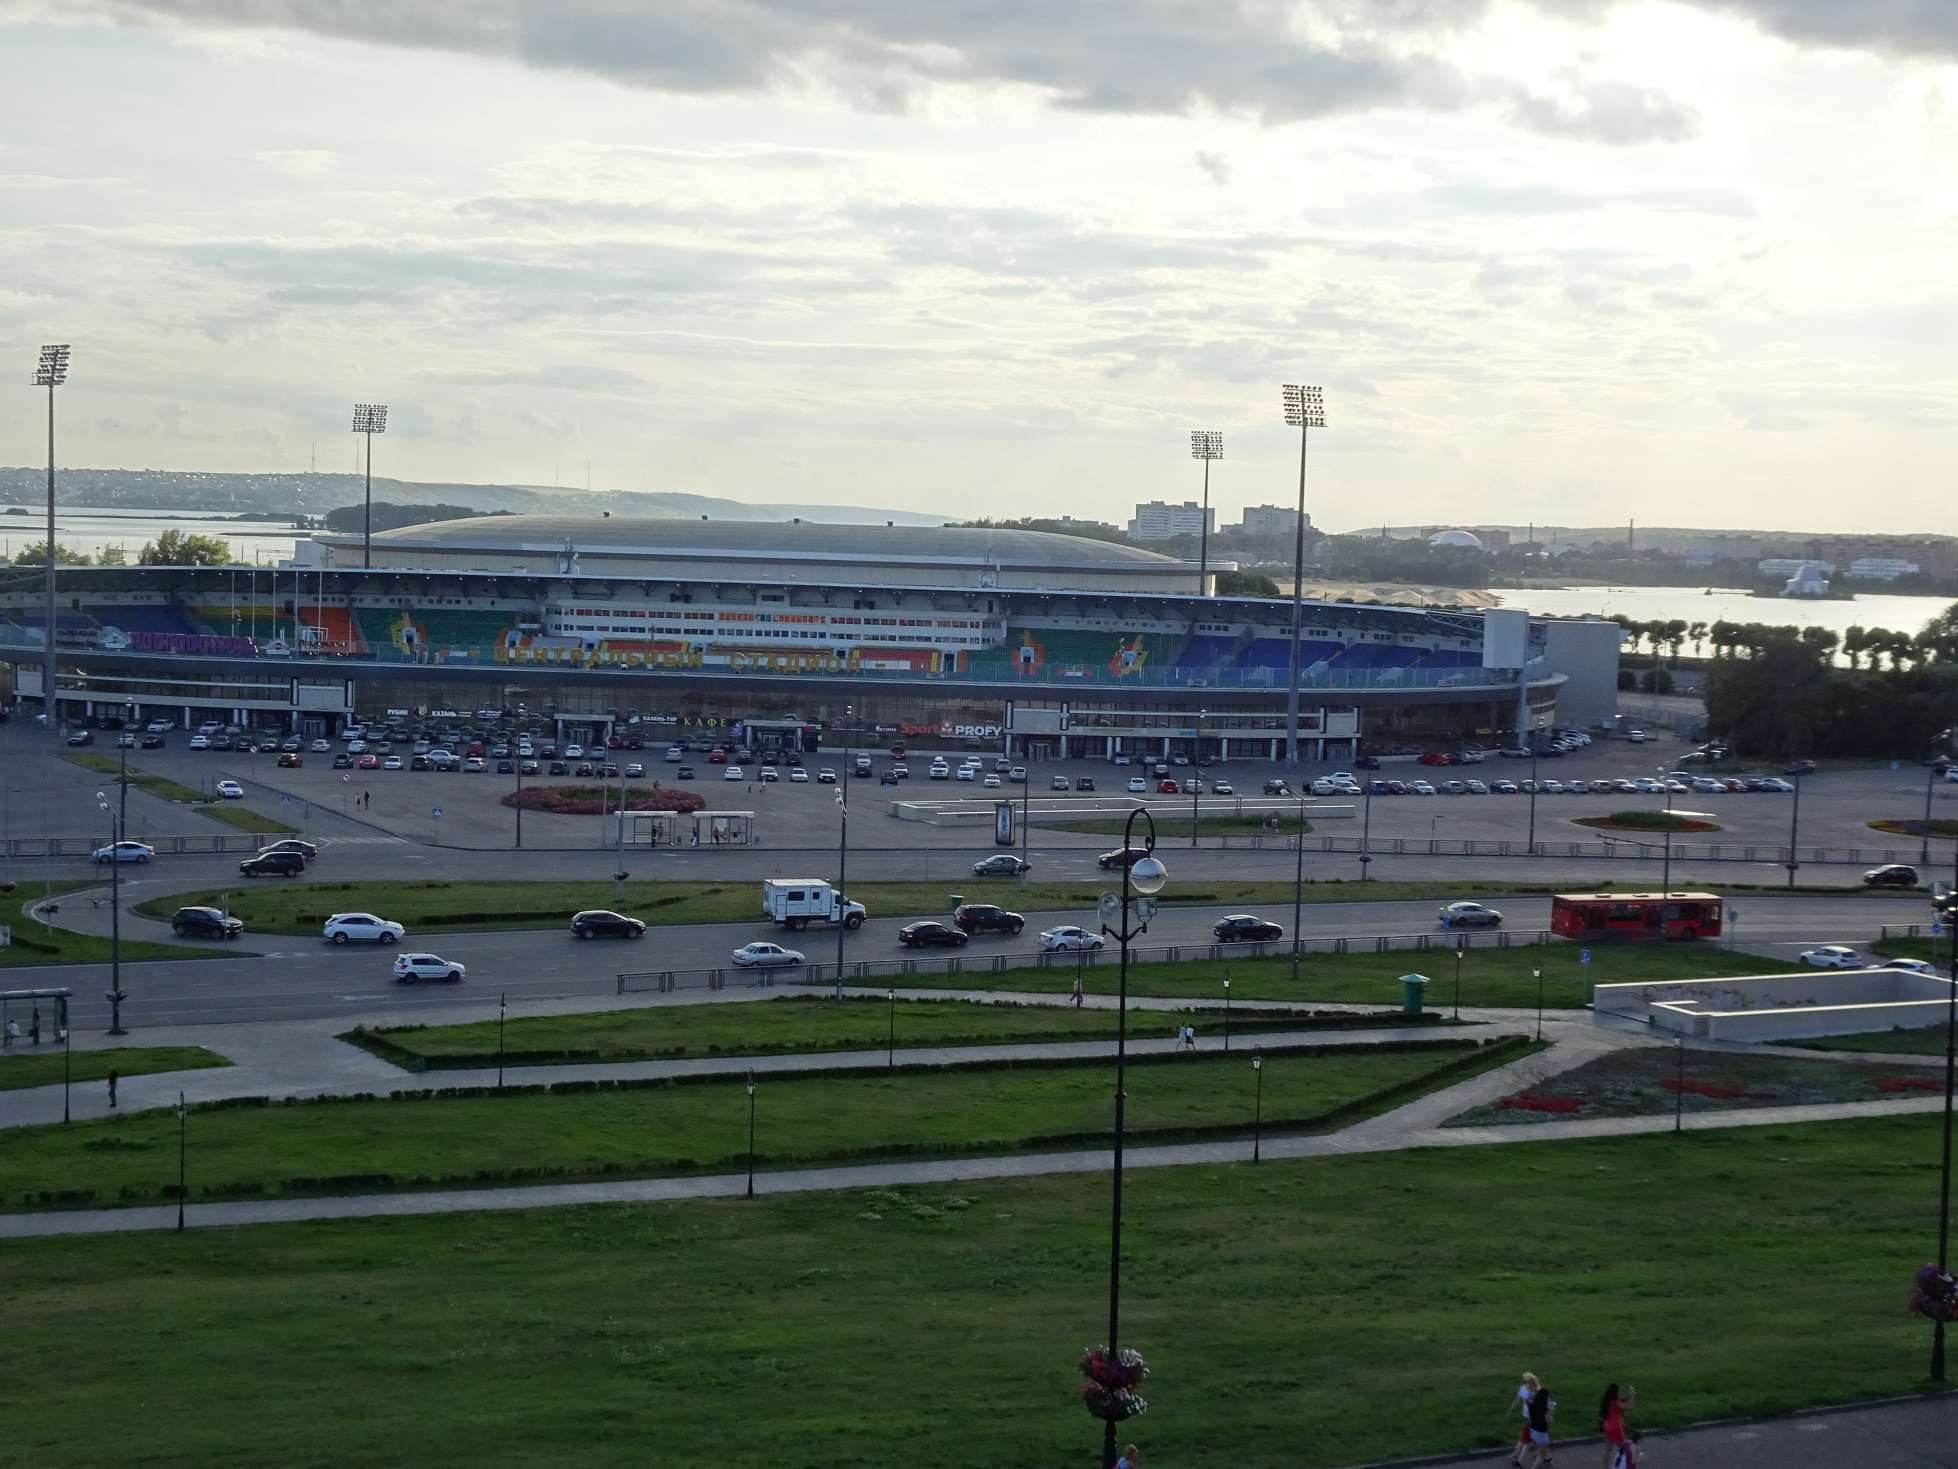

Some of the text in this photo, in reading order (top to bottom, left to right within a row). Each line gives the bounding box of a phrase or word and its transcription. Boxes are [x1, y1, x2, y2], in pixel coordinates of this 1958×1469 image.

[492, 646, 860, 673] ЦЕНТРАЛЬНЫЙ СТАДИОН
[684, 717, 727, 727] КАФЕ
[901, 722, 939, 735] Sport
[955, 725, 1003, 736] PROFY
